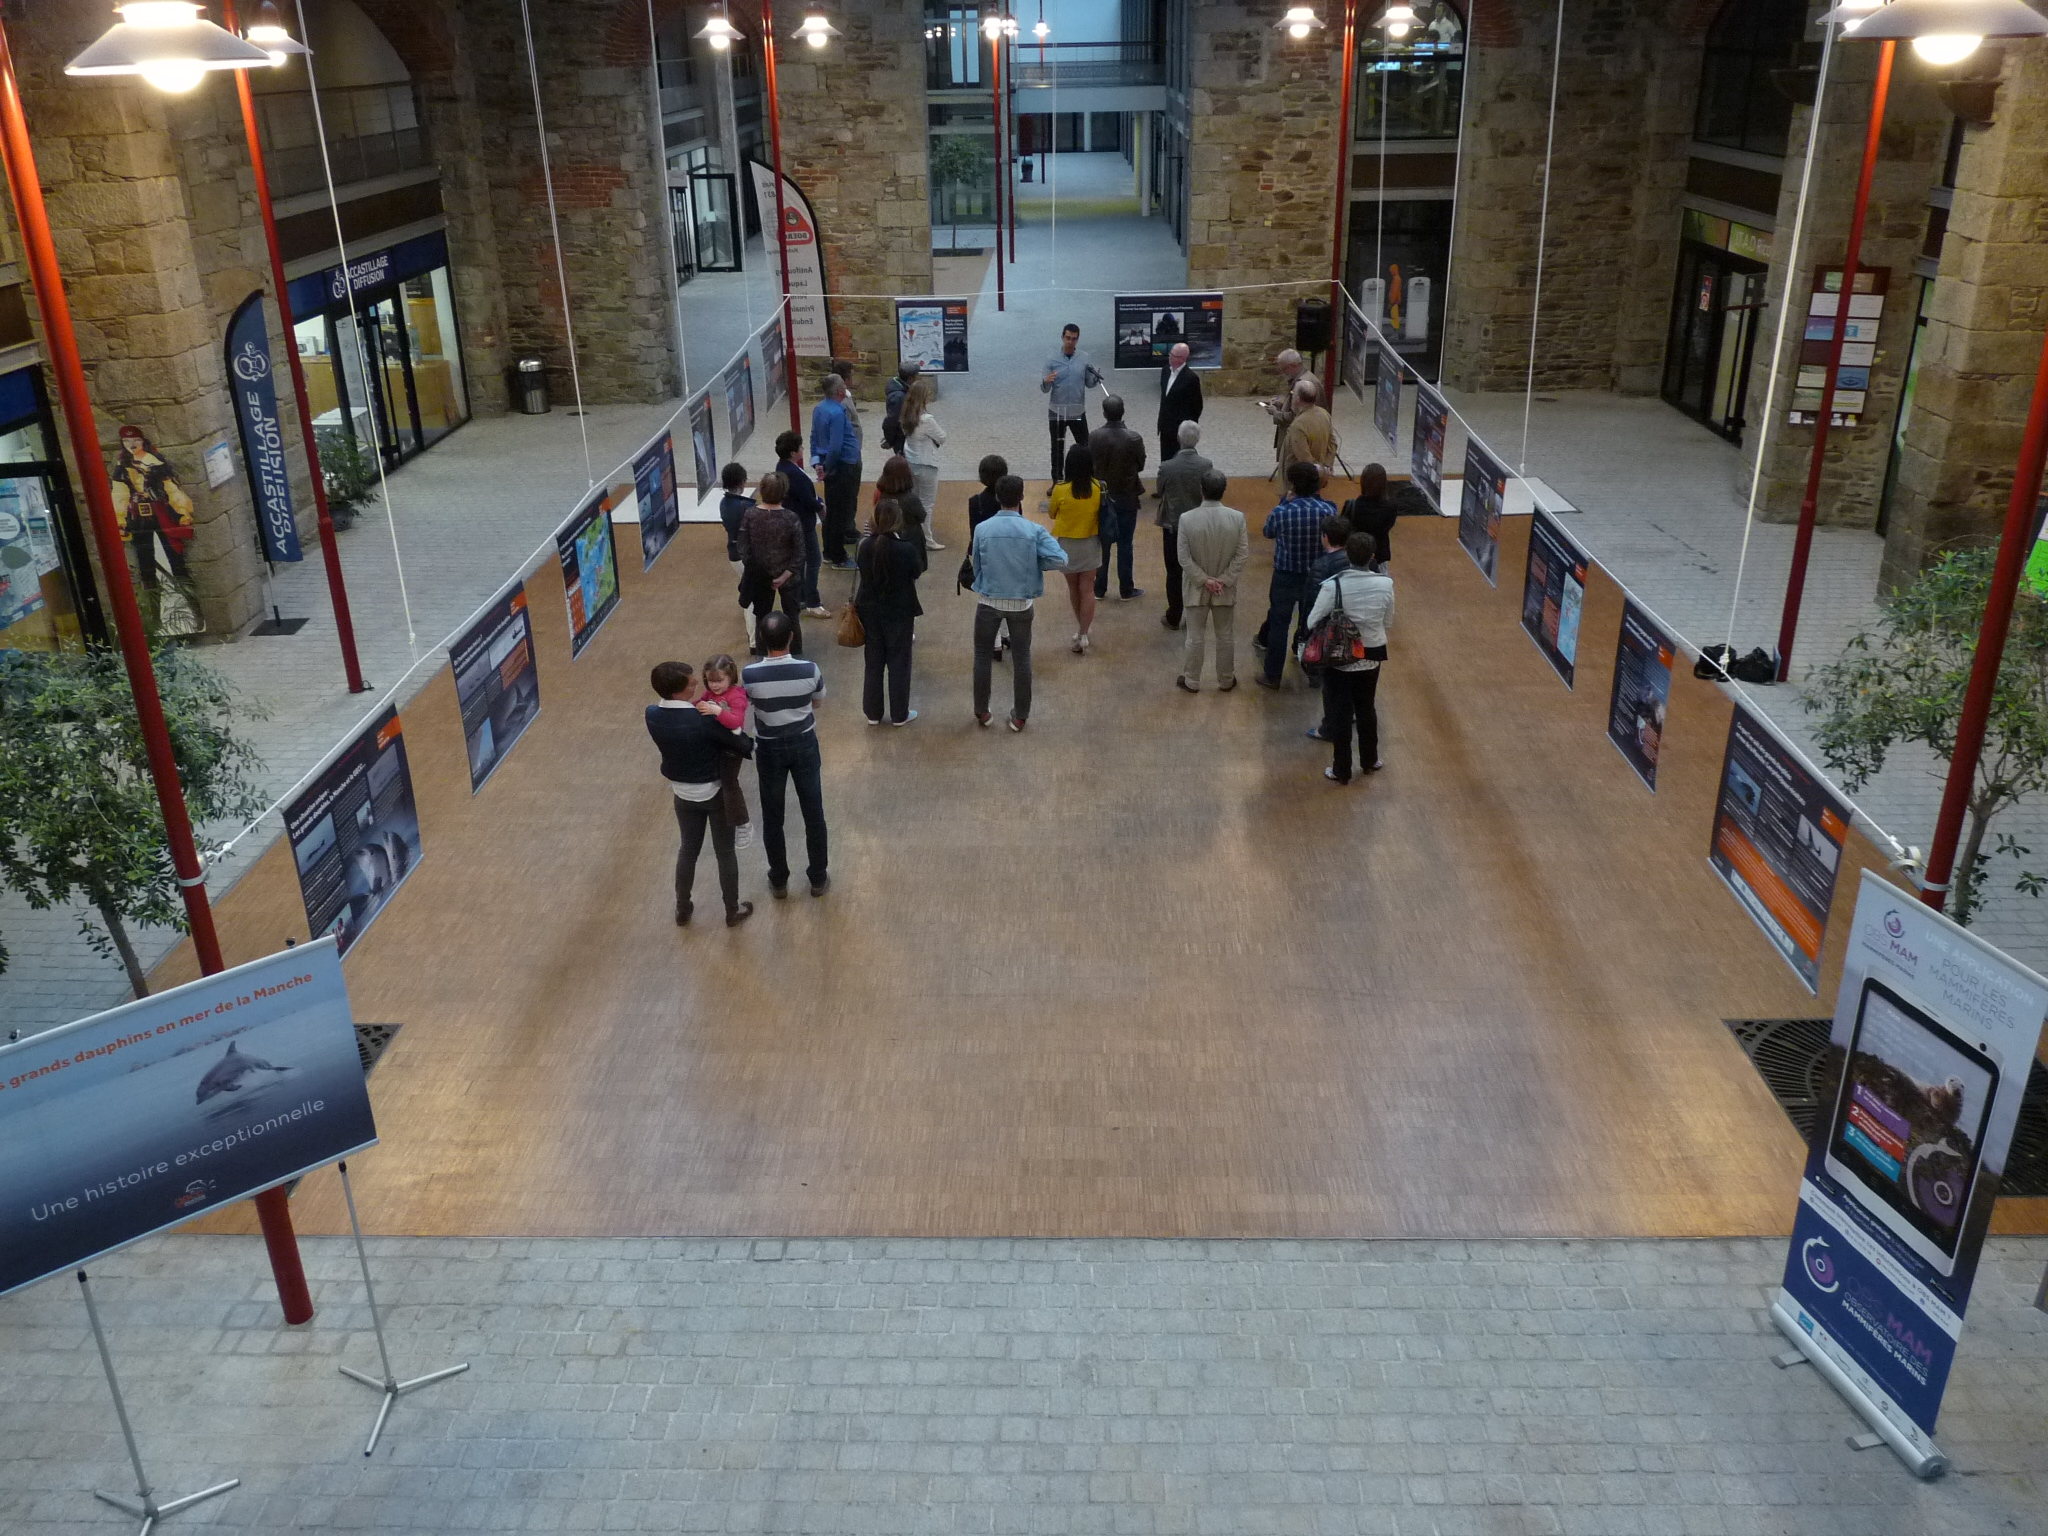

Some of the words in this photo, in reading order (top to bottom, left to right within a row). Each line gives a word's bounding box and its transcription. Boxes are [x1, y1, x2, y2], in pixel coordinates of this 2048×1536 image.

[353, 269, 385, 290] DIFFUSION
[247, 391, 288, 555] ACCASTILLAGE
[1890, 939, 1918, 966] MAM
[1926, 930, 1948, 951] UNE
[1951, 950, 2034, 1006] APPLICATION
[1929, 965, 2014, 1029] MAMMIFÈRES
[1941, 958, 1979, 988] POUR
[1982, 983, 2007, 1007] LES
[10, 1058, 71, 1089] grands
[75, 1030, 152, 1063] dauphins
[156, 1022, 176, 1035] en
[180, 1008, 211, 1027] mer
[214, 1001, 234, 1015] de
[236, 995, 251, 1006] la
[253, 973, 313, 1000] Manche
[1942, 990, 1992, 1030] MARINS
[1851, 1106, 1859, 1117] 2
[1857, 1085, 1862, 1095] 1
[1847, 1125, 1855, 1136] 3
[31, 1197, 79, 1221] Une
[84, 1161, 169, 1202] histoire
[175, 1099, 325, 1166] exceptionnelle
[1842, 1299, 1892, 1353] MAMMIFÈRES
[1894, 1351, 1926, 1385] MARINS
[1844, 1292, 1910, 1357] OBSERVATOIRE
[1911, 1354, 1928, 1377] DES
[1886, 1312, 1933, 1365] MAM
